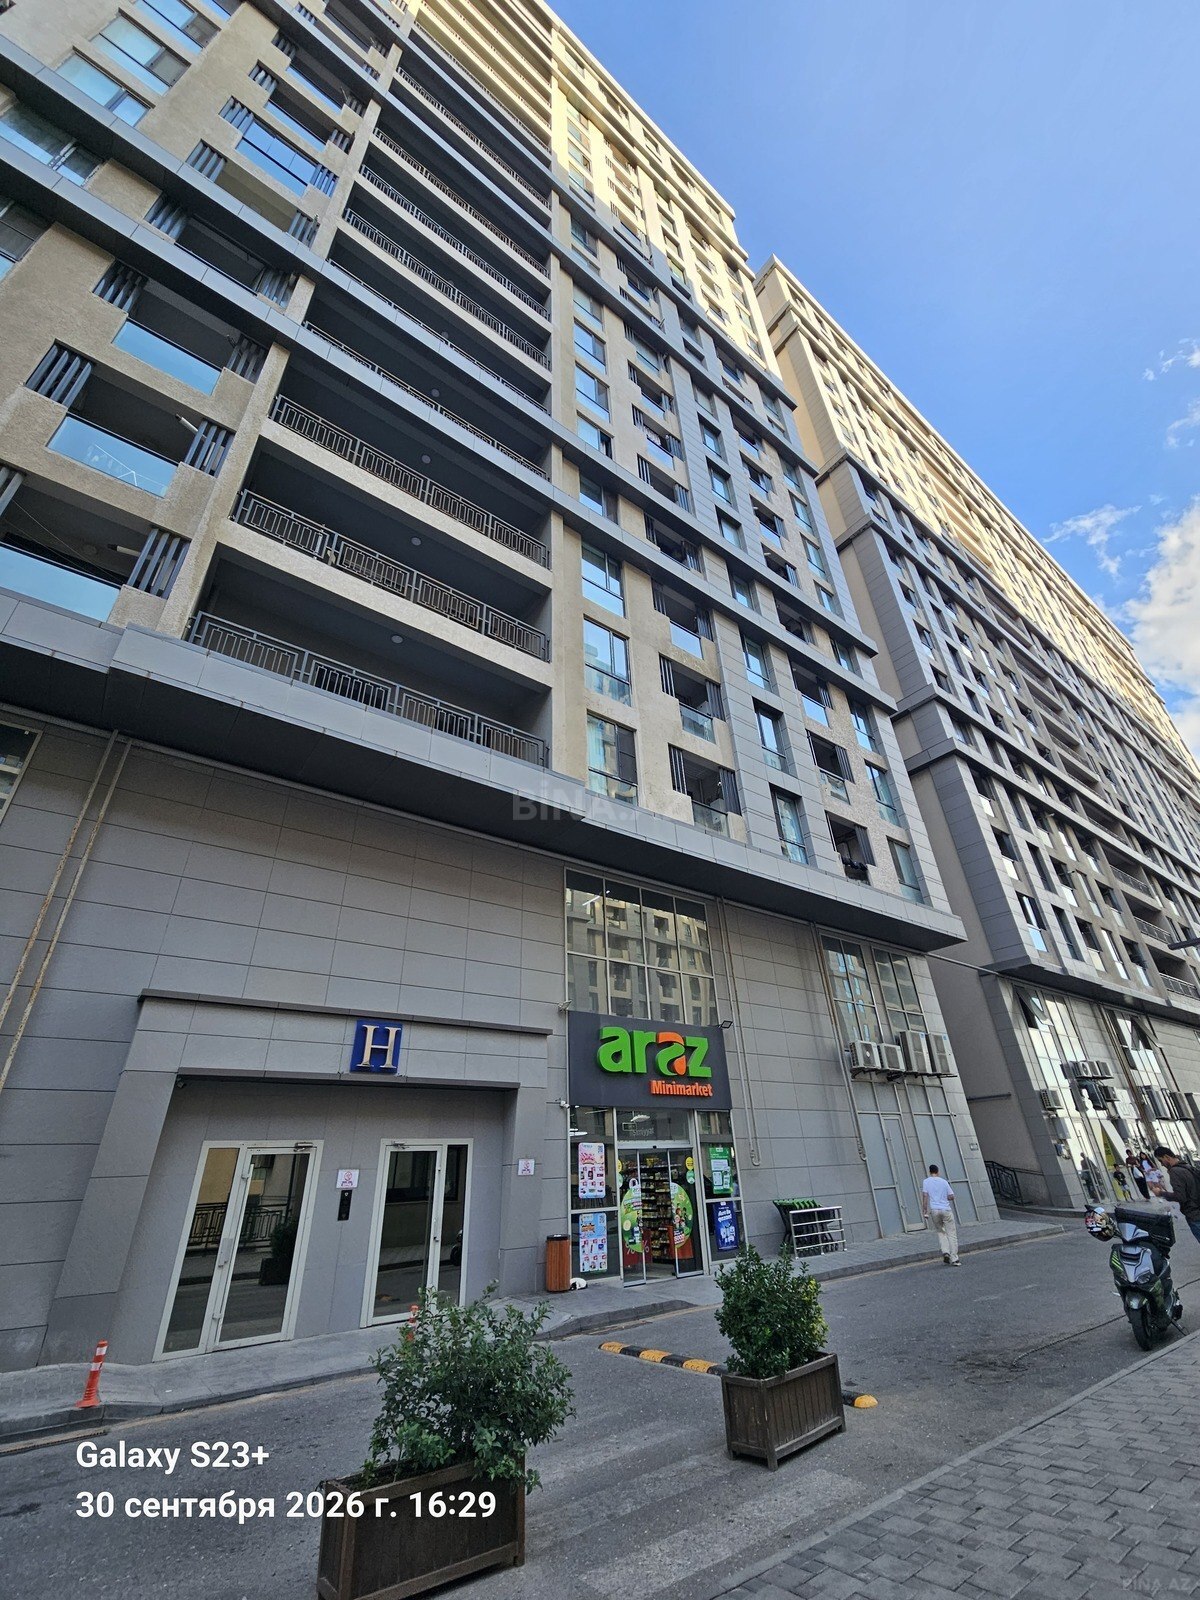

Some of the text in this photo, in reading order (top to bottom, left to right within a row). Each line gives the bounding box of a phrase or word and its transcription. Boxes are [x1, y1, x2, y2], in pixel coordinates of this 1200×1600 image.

[356, 1024, 402, 1069] H
[597, 1026, 712, 1078] araz
[650, 1080, 713, 1097] Minimarket
